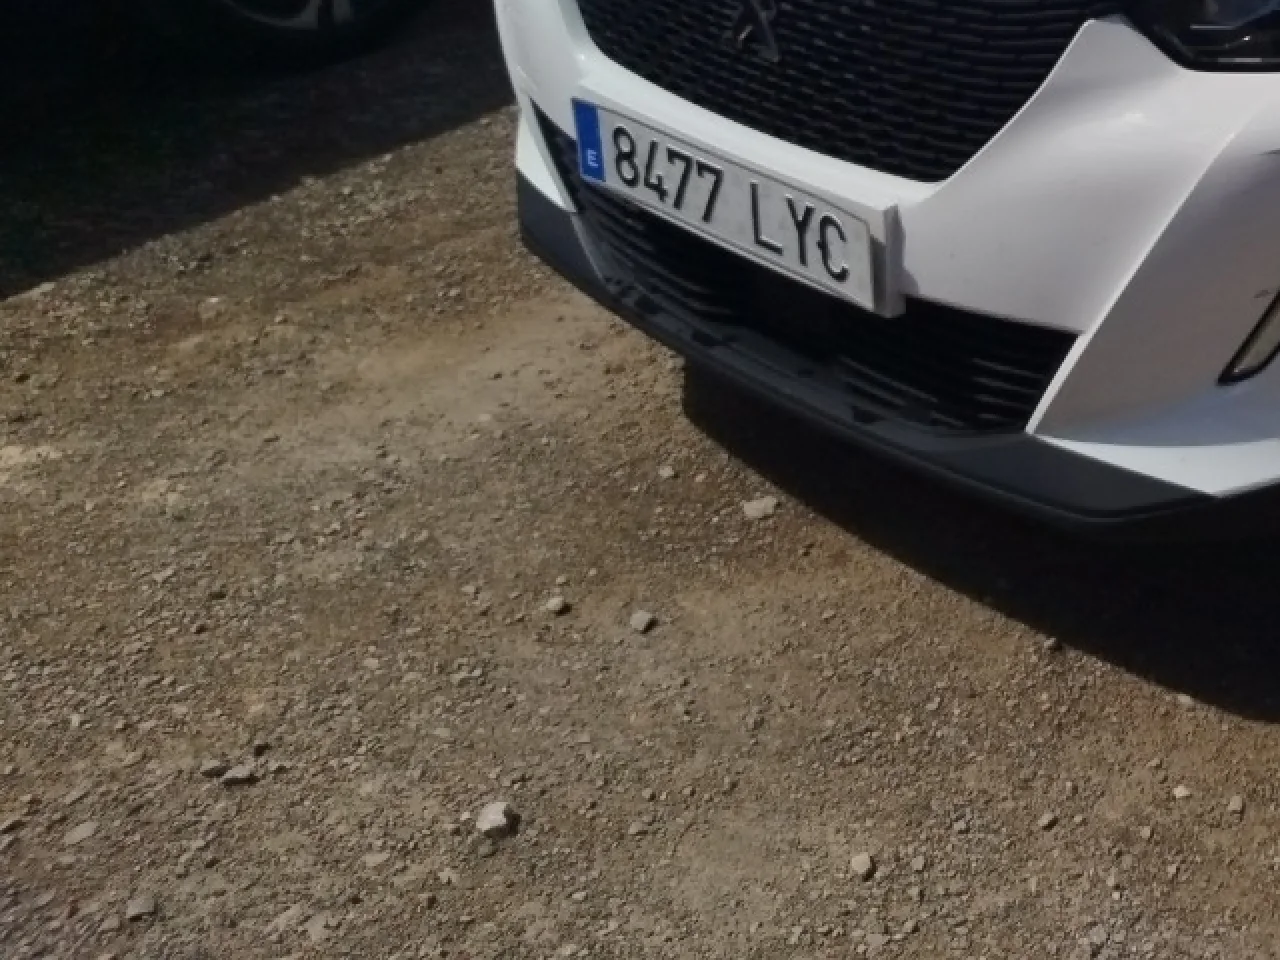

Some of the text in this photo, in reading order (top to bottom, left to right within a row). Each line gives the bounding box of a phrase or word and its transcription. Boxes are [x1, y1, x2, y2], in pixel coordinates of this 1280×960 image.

[587, 149, 599, 168] E
[613, 124, 849, 283] 8477 LYC
